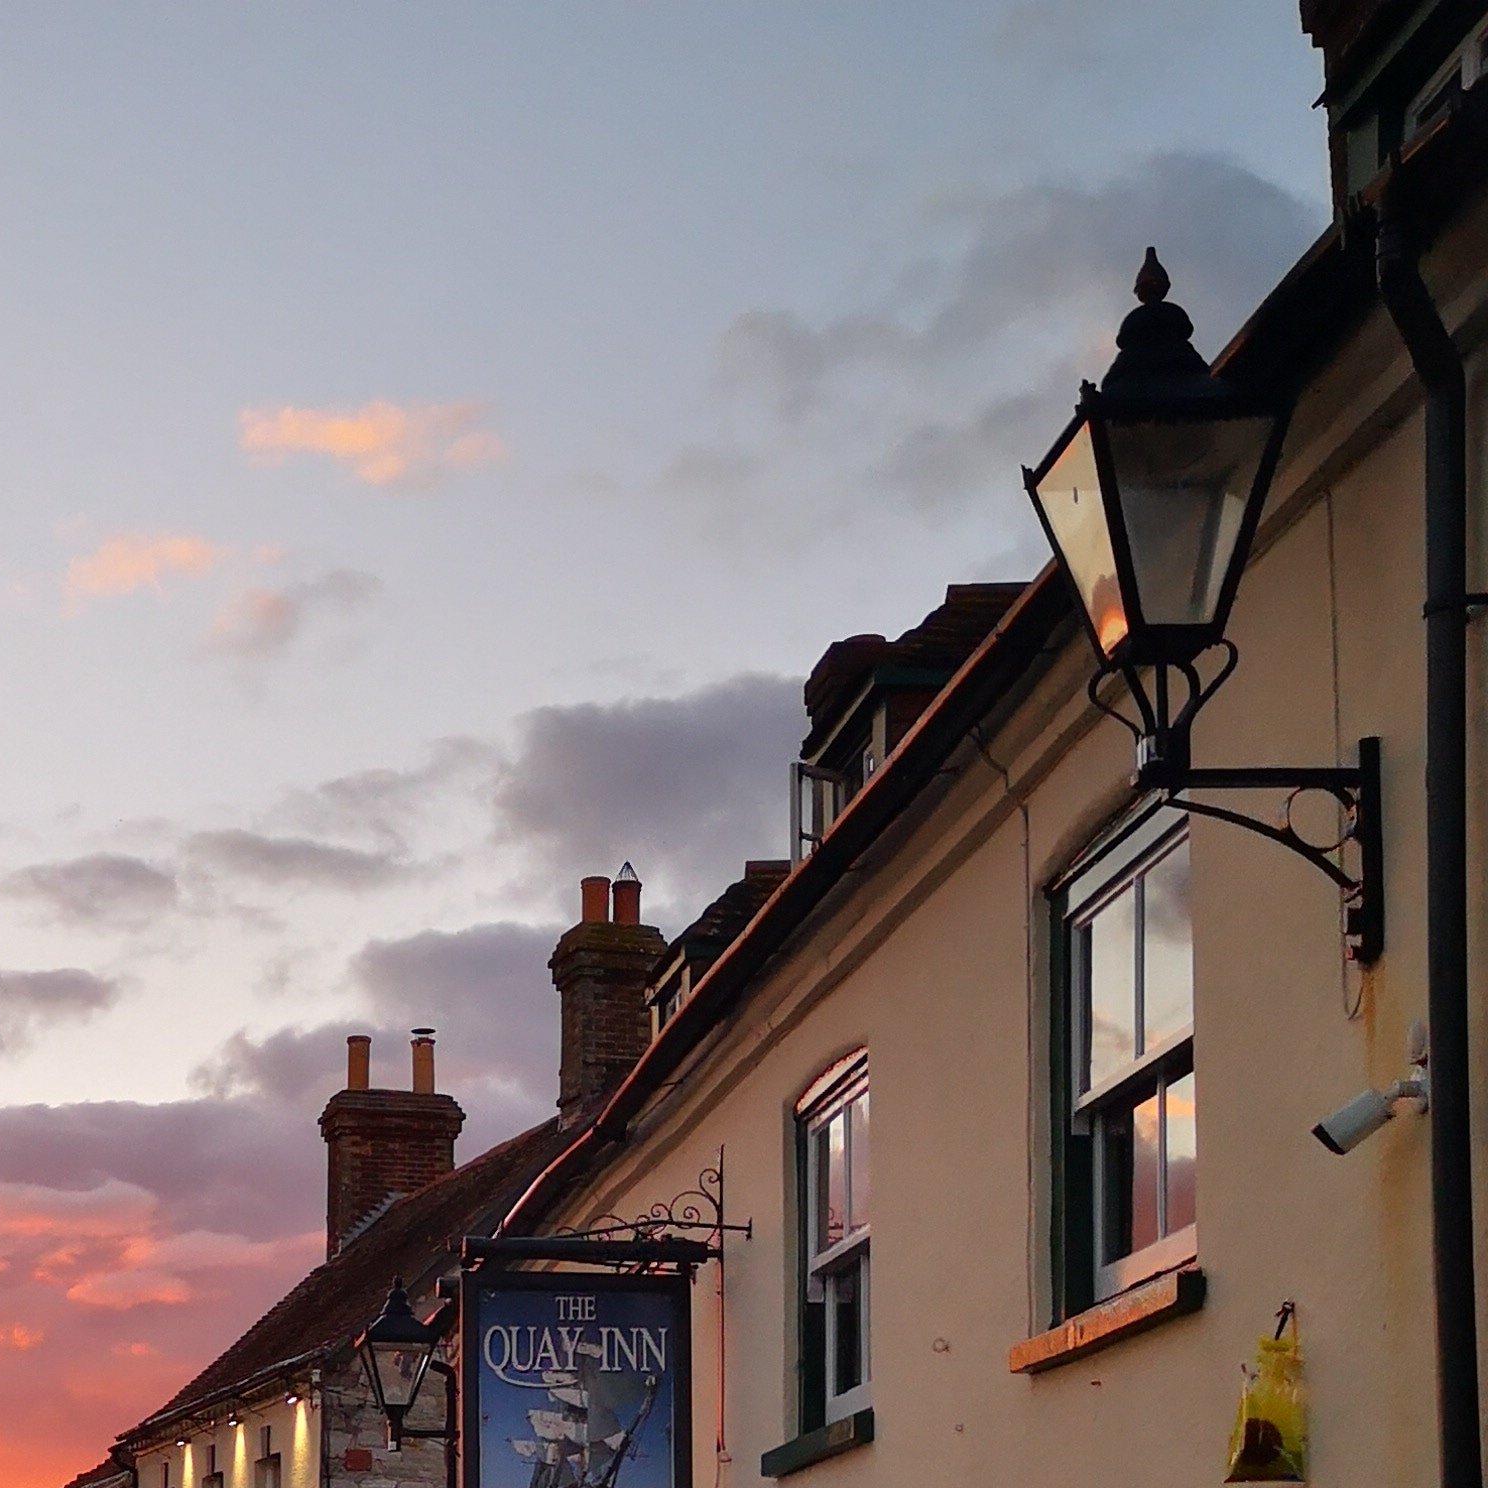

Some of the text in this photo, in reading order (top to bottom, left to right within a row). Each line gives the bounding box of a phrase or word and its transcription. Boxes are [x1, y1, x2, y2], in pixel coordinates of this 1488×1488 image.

[556, 1296, 597, 1321] THE
[483, 1324, 668, 1388] QUAY INN
